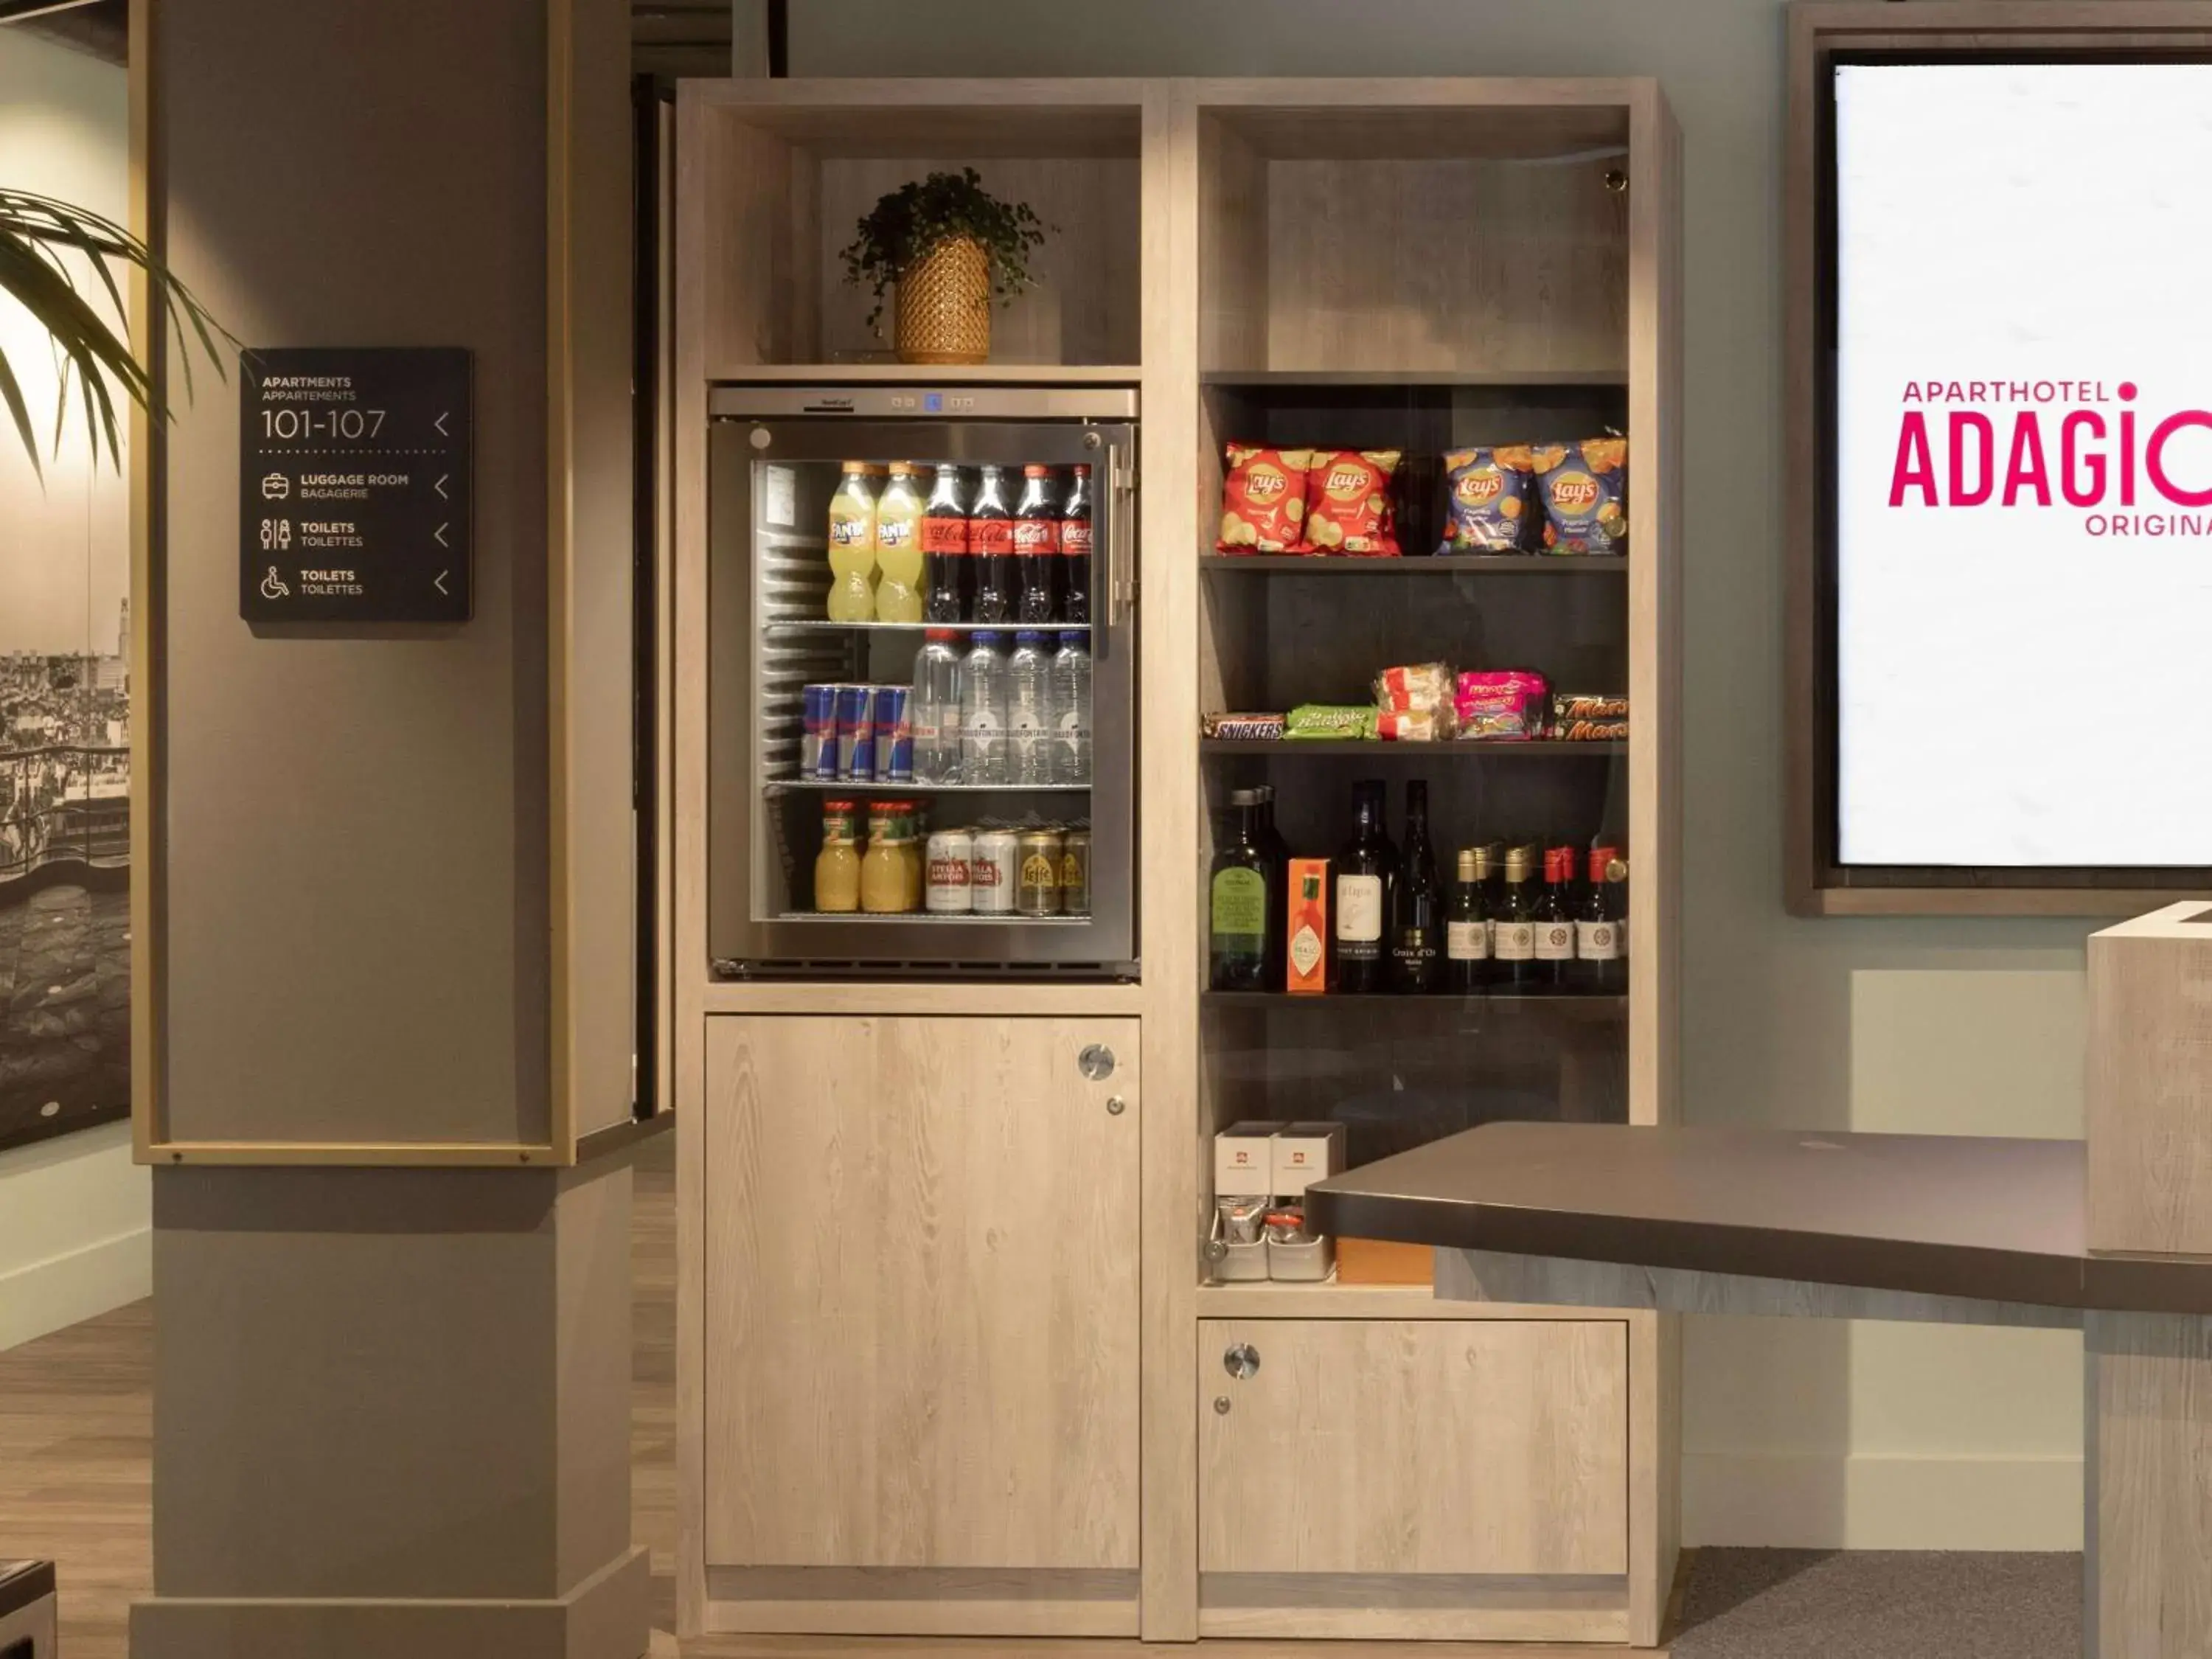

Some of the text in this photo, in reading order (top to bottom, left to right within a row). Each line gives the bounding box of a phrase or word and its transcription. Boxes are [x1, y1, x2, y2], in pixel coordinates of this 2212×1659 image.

[262, 377, 352, 387] APARTMENTS
[262, 391, 356, 401] APPARTEMENTS
[1902, 380, 2110, 403] APARTHOTEL
[261, 409, 386, 439] 101-107
[301, 474, 409, 485] LUGGAGE ROOM
[301, 488, 369, 498] BAGAGERIE
[301, 523, 355, 533] TOILETS
[2085, 515, 2212, 536] ORIGIN
[301, 536, 364, 546] TOILETTES
[301, 570, 355, 581] TOILETS
[301, 585, 363, 595] TOILETTES
[1218, 721, 1284, 740] SNICKERS
